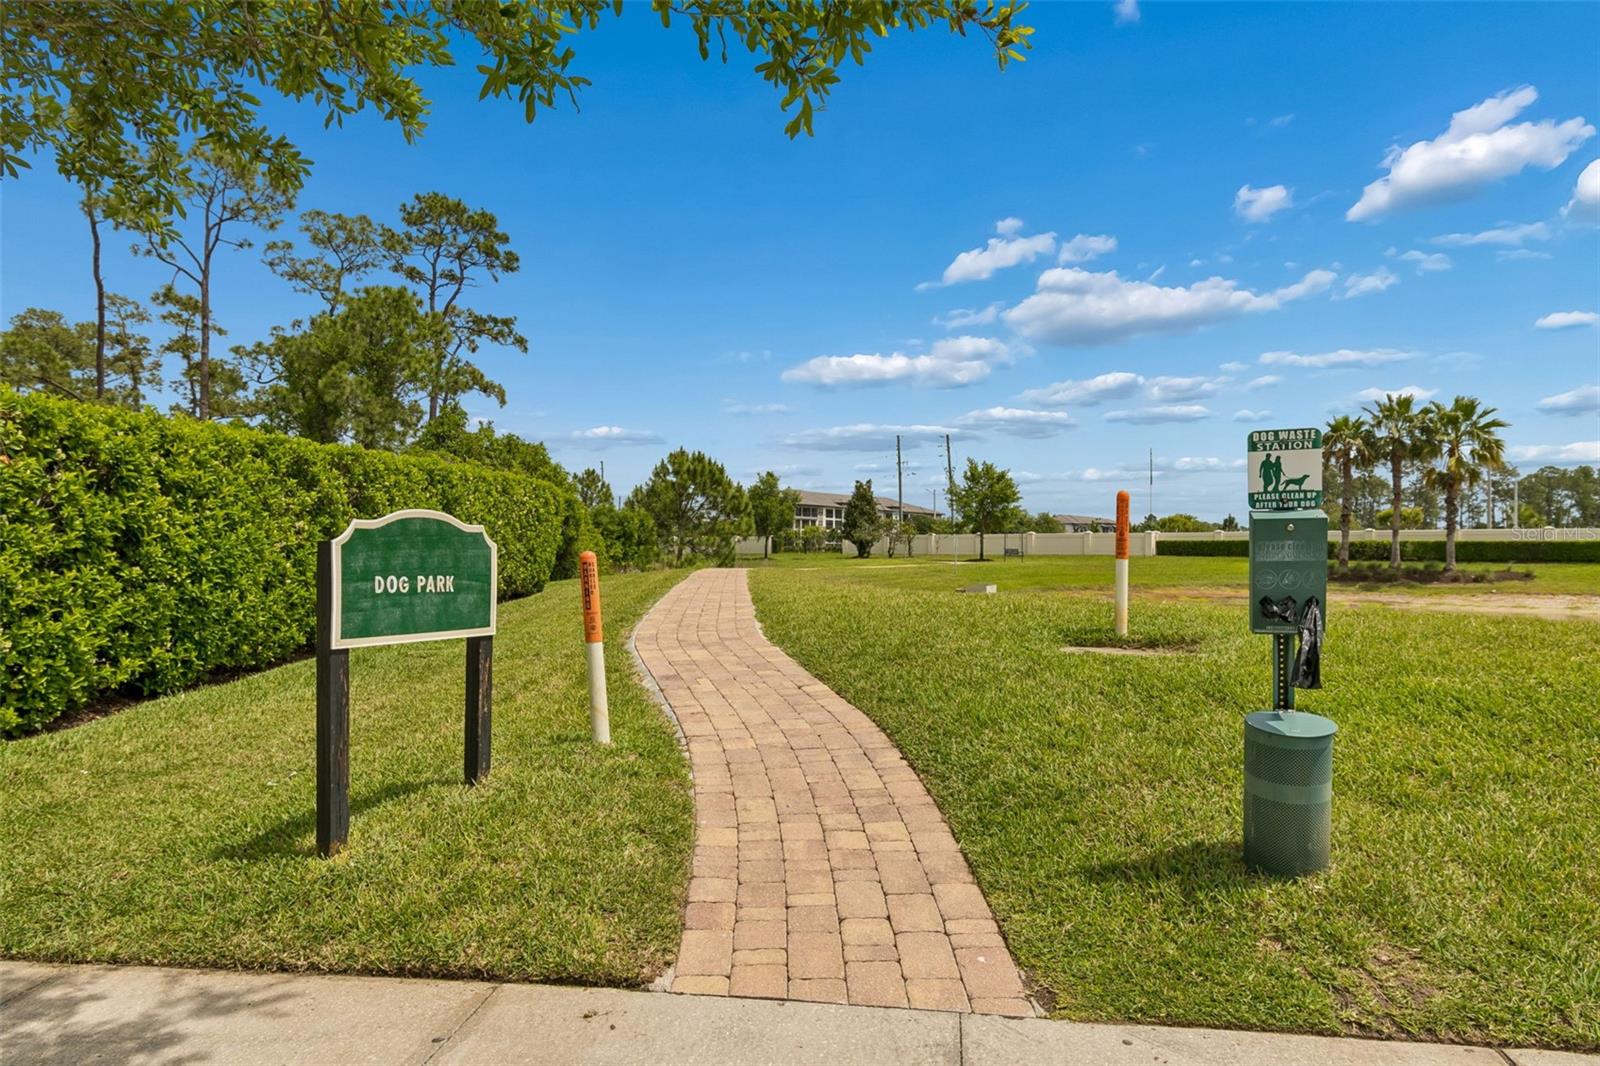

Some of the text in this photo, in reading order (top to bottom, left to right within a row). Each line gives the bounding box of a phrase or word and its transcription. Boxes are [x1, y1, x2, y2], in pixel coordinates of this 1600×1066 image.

[1253, 429, 1316, 442] DOG WASTE
[1257, 440, 1313, 451] STATION
[1281, 491, 1305, 499] CLEAN
[1306, 491, 1317, 499] UP
[1255, 501, 1277, 509] AFTER
[374, 575, 455, 594] DOG PARK
